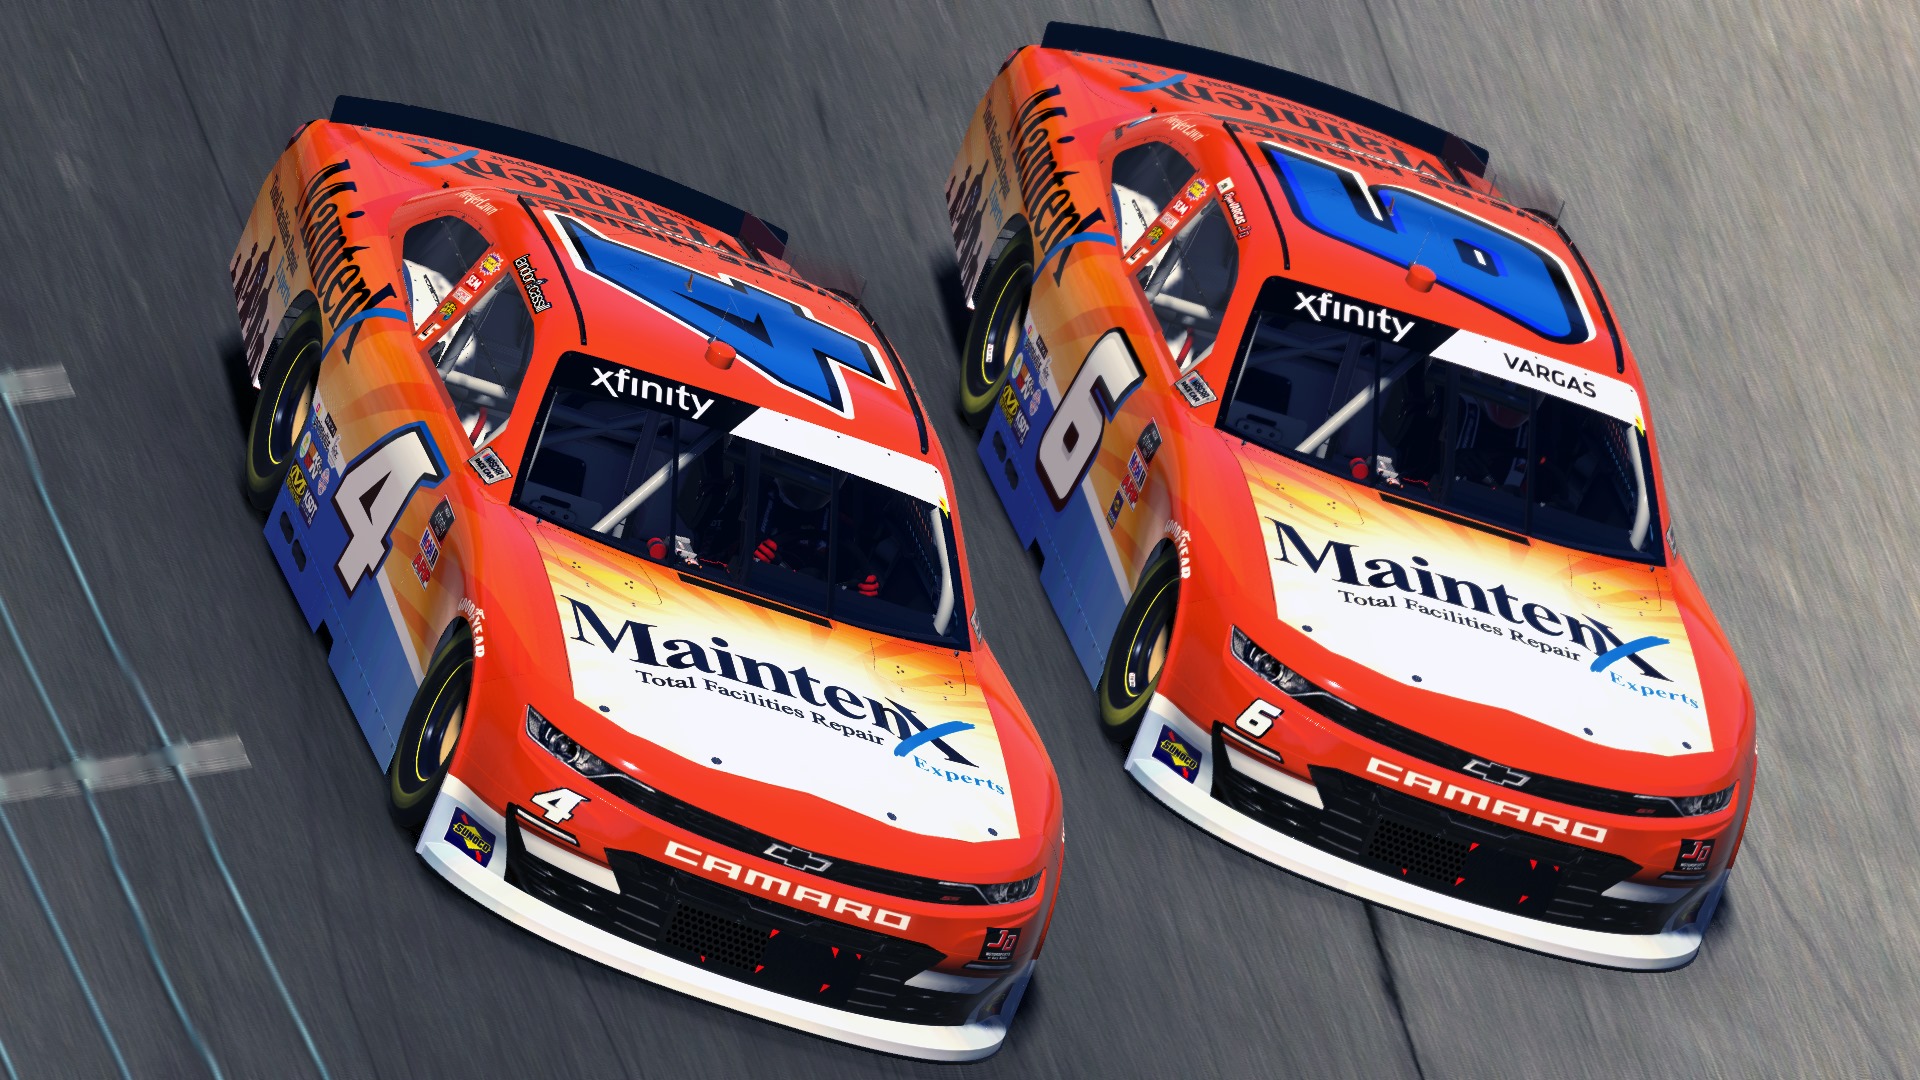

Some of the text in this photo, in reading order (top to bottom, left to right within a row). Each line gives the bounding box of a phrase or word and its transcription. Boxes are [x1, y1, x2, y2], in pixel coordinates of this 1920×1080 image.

[1257, 139, 1597, 345] 6
[543, 209, 897, 419] 4
[1294, 291, 1415, 342] xfinity
[591, 366, 715, 419] xfinity
[1502, 352, 1597, 399] VARGAS
[1035, 327, 1147, 512] 6
[331, 421, 450, 599] 4
[1264, 515, 1674, 682] MaintenX
[1337, 589, 1581, 662] Total Facilities Repair
[560, 594, 979, 768] MaintenX
[635, 669, 884, 746] Total Facilities Repair
[1609, 670, 1699, 709] Experts
[1160, 738, 1198, 770] SUNOCO
[1235, 697, 1285, 739] 6
[530, 787, 591, 824] 4
[913, 755, 1005, 796] Experts
[1366, 756, 1608, 843] CAMARO
[454, 822, 491, 854] SUNOCO
[664, 840, 912, 931] CAMARO
